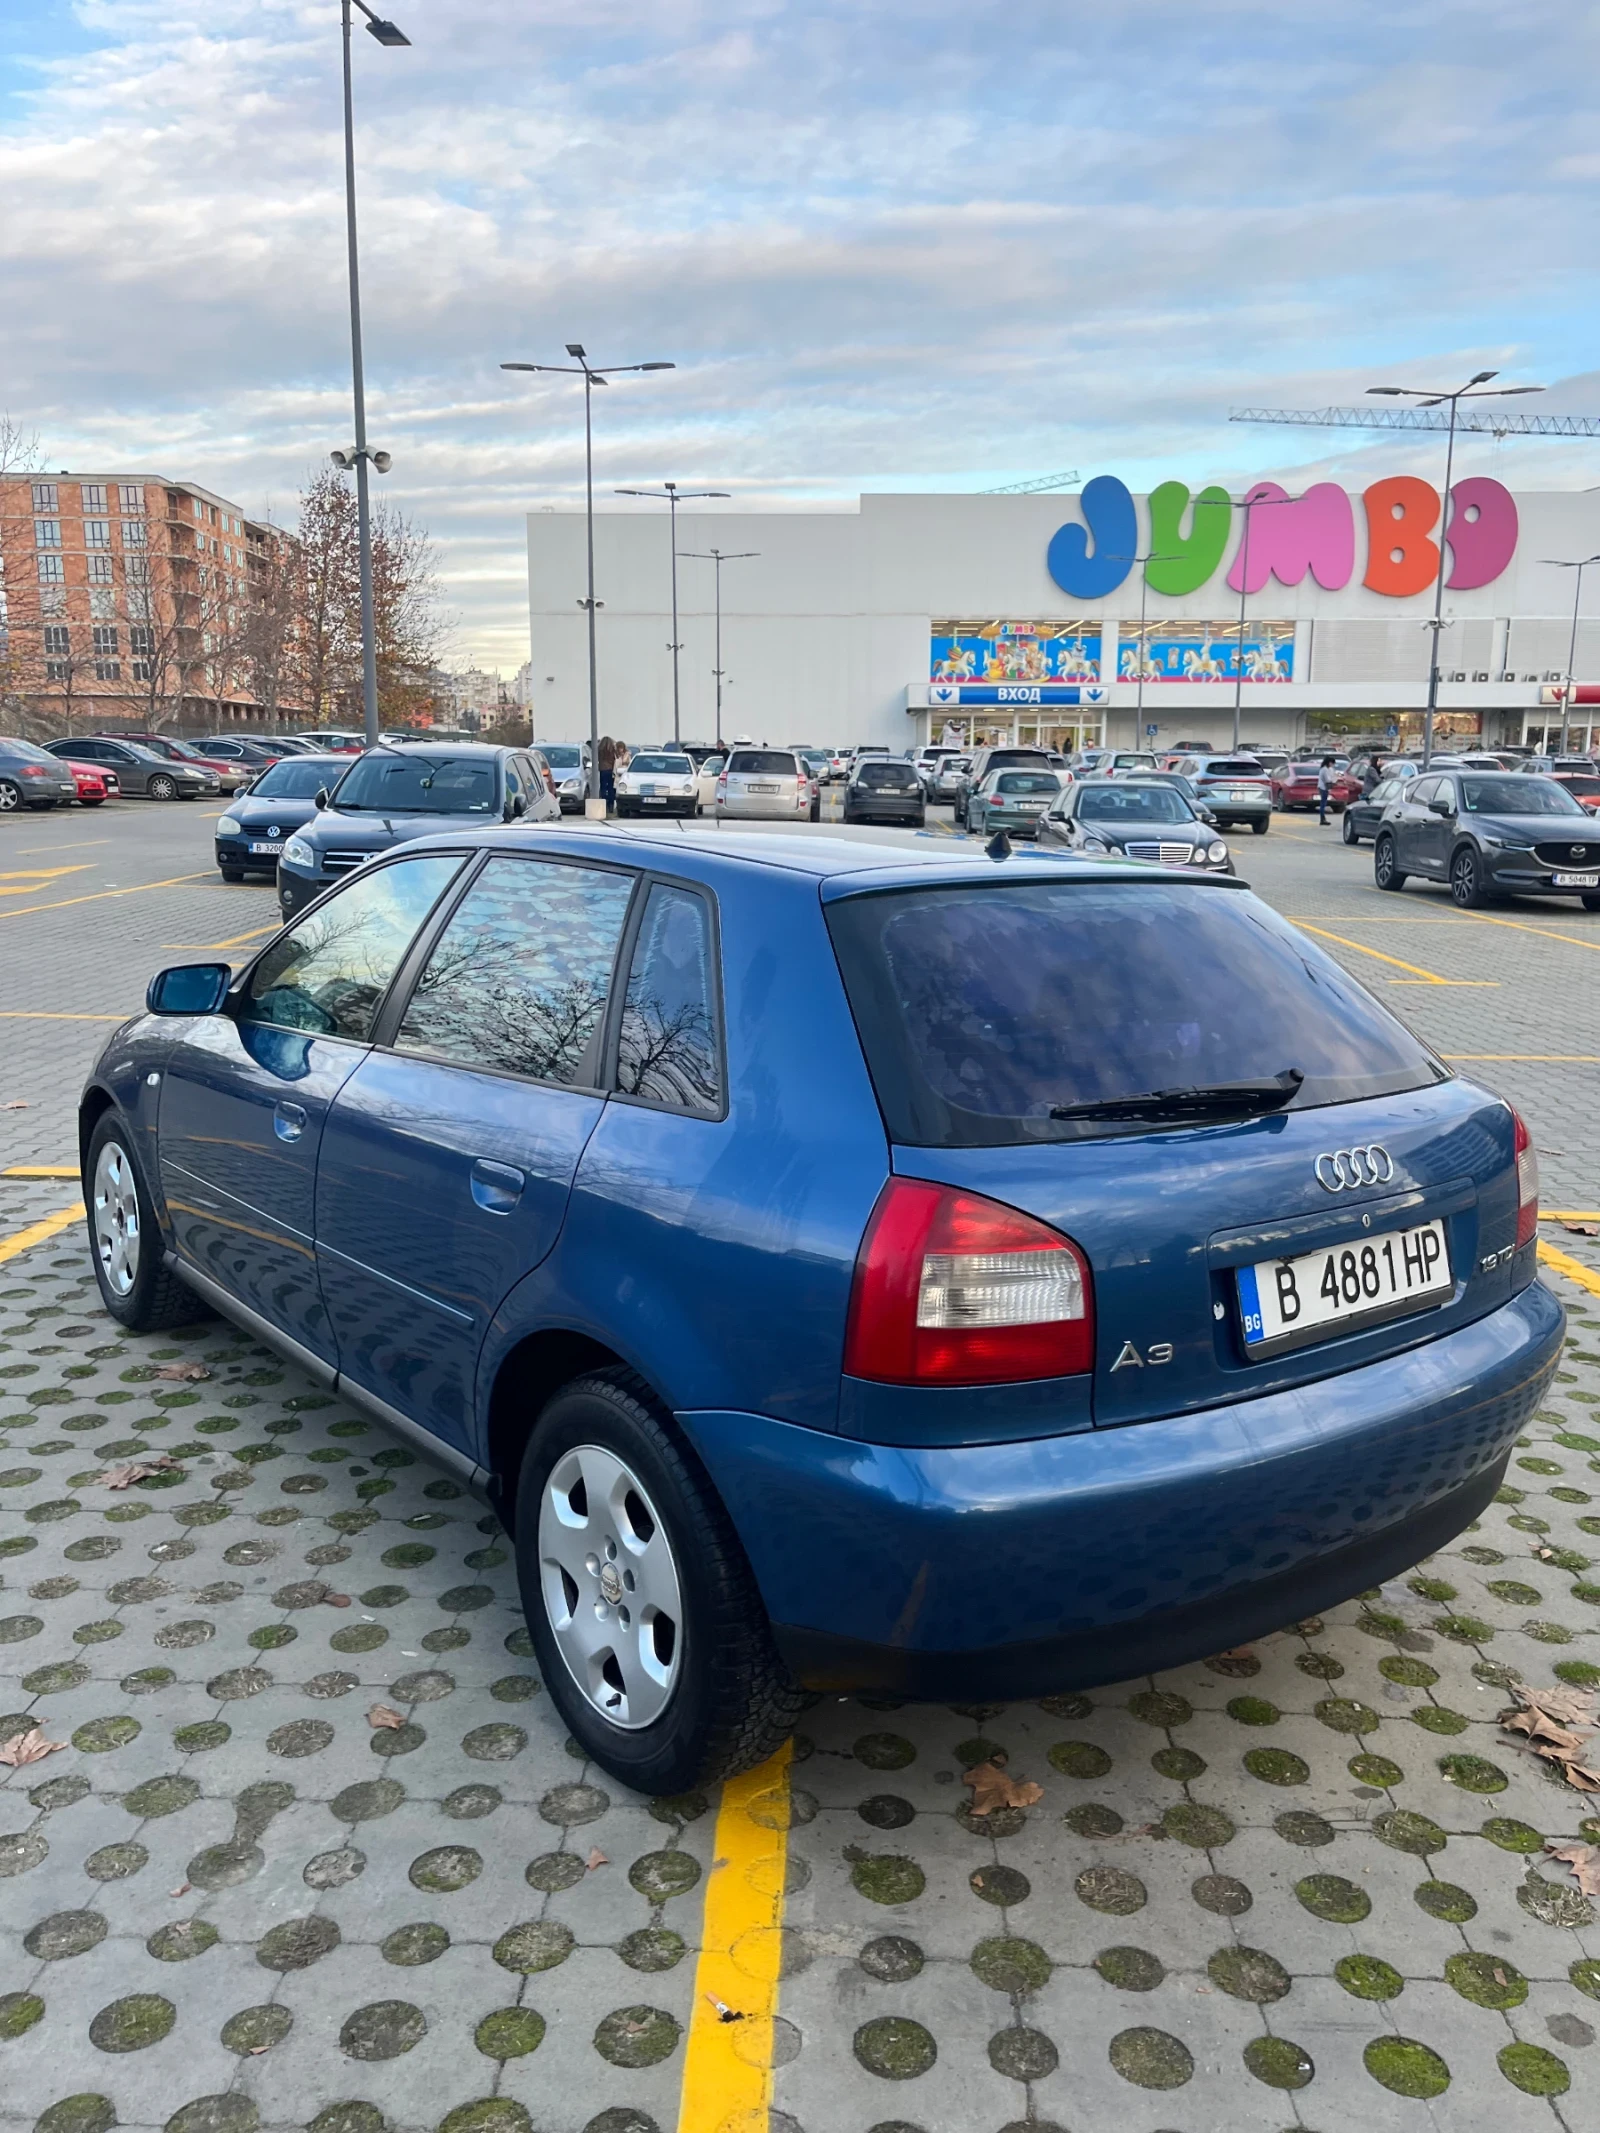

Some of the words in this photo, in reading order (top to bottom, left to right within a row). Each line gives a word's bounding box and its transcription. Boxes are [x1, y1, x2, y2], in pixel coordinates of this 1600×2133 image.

[1047, 475, 1518, 599] JUMBO
[998, 687, 1041, 703] ВХОД
[1275, 1265, 1300, 1323] B
[1244, 1312, 1261, 1333] BG
[1109, 1340, 1173, 1373] A3
